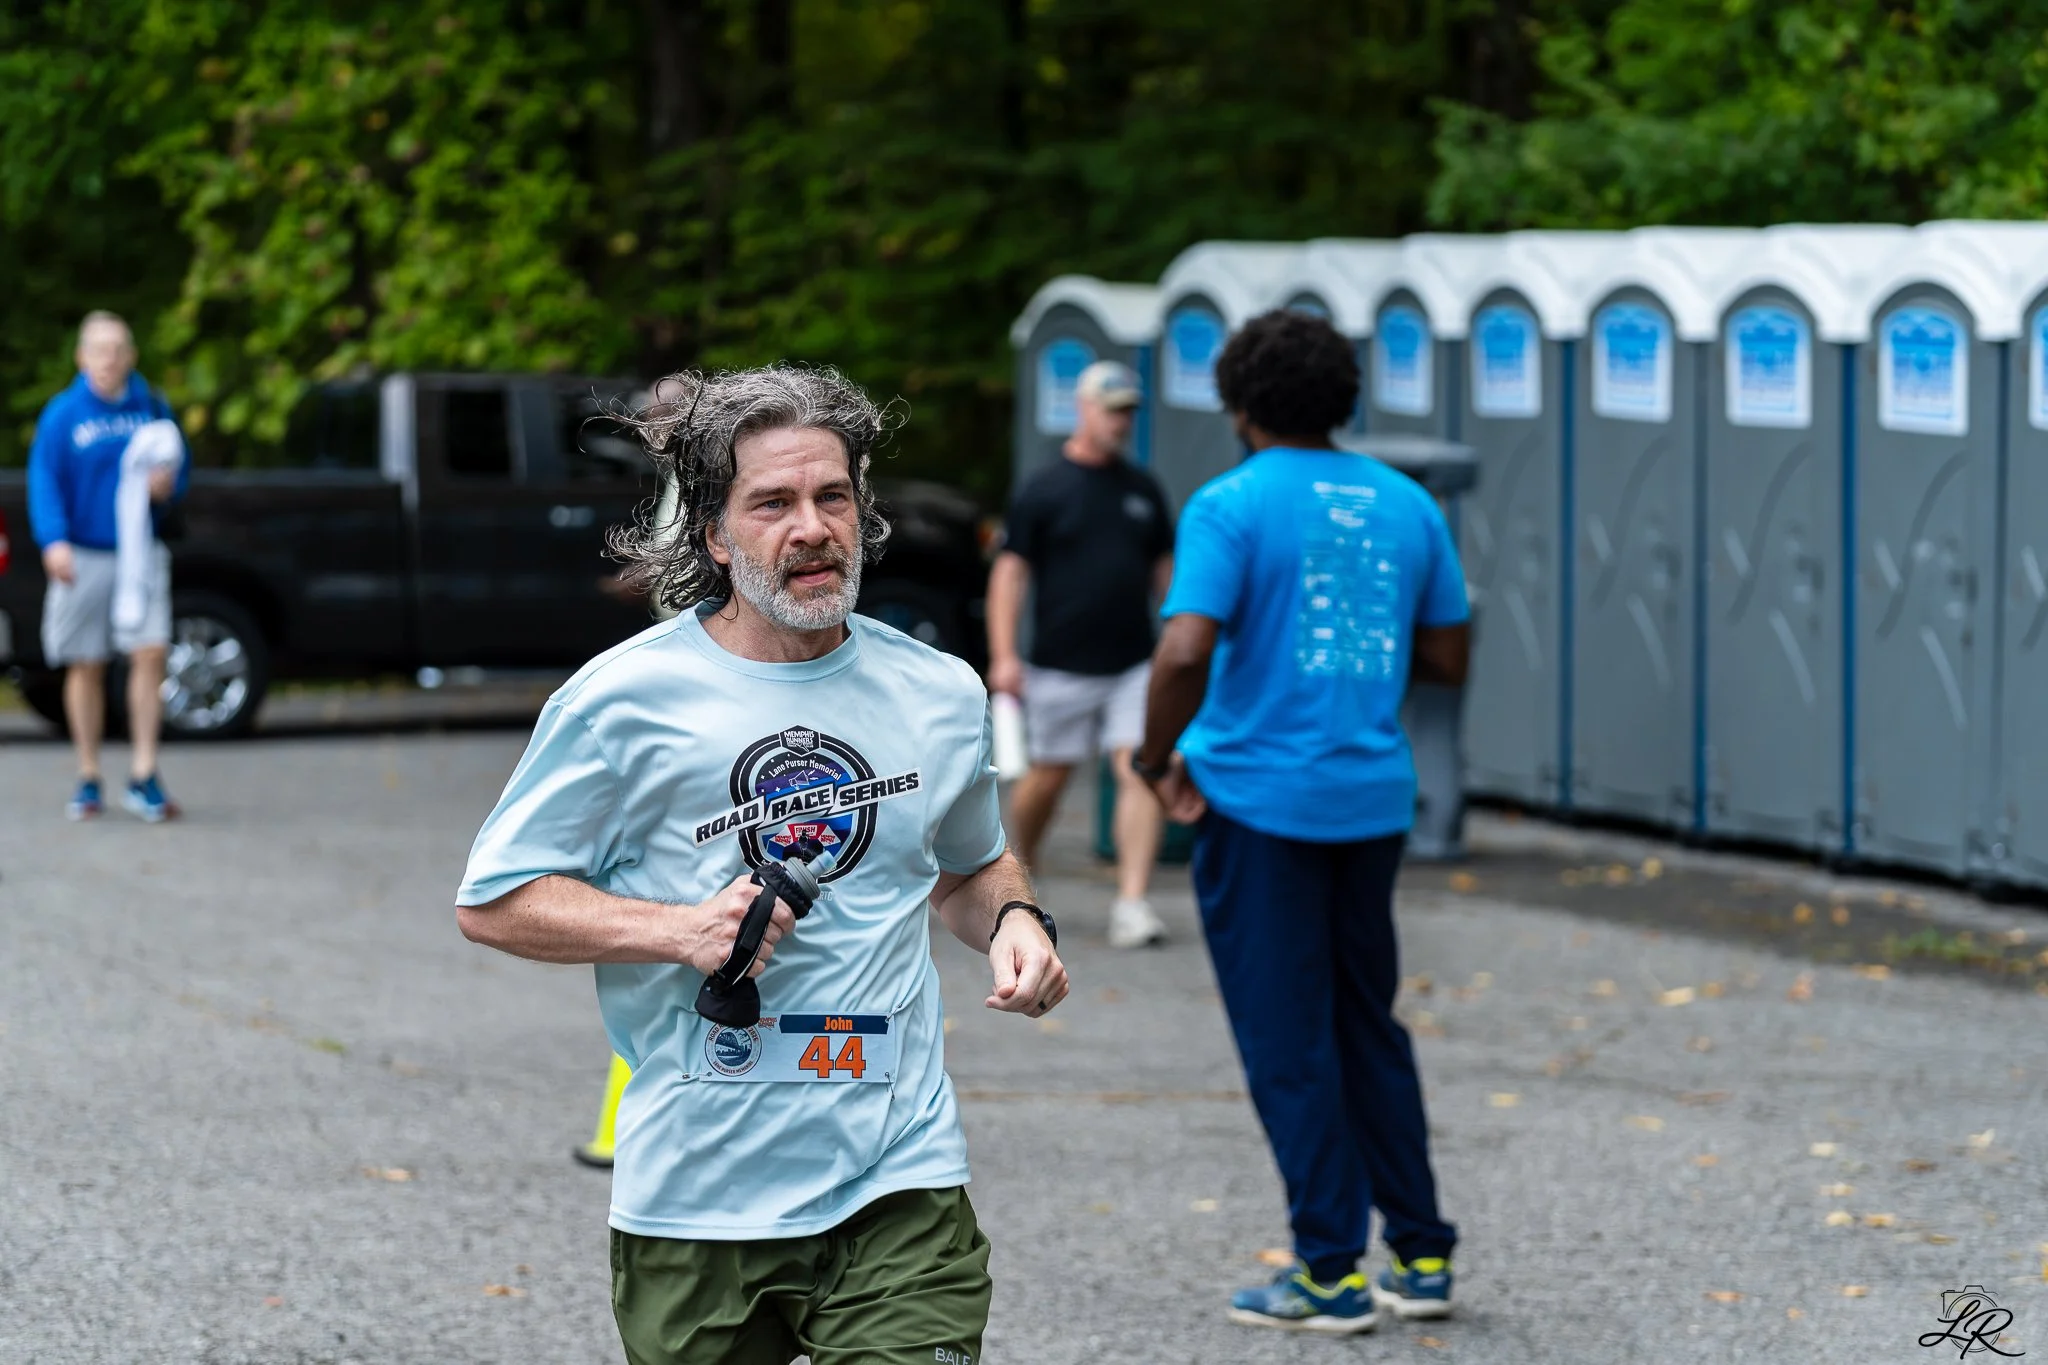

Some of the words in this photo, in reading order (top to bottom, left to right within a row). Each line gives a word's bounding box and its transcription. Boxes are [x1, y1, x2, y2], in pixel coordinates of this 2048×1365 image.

[784, 730, 815, 738] MEMPHIS
[768, 763, 786, 778] Lane
[784, 760, 809, 769] Purser
[809, 759, 842, 781] Memorial
[696, 803, 760, 844] ROAD
[771, 788, 831, 820] RACE
[840, 772, 920, 807] SERIES
[824, 1016, 853, 1031] John
[798, 1035, 867, 1079] 44
